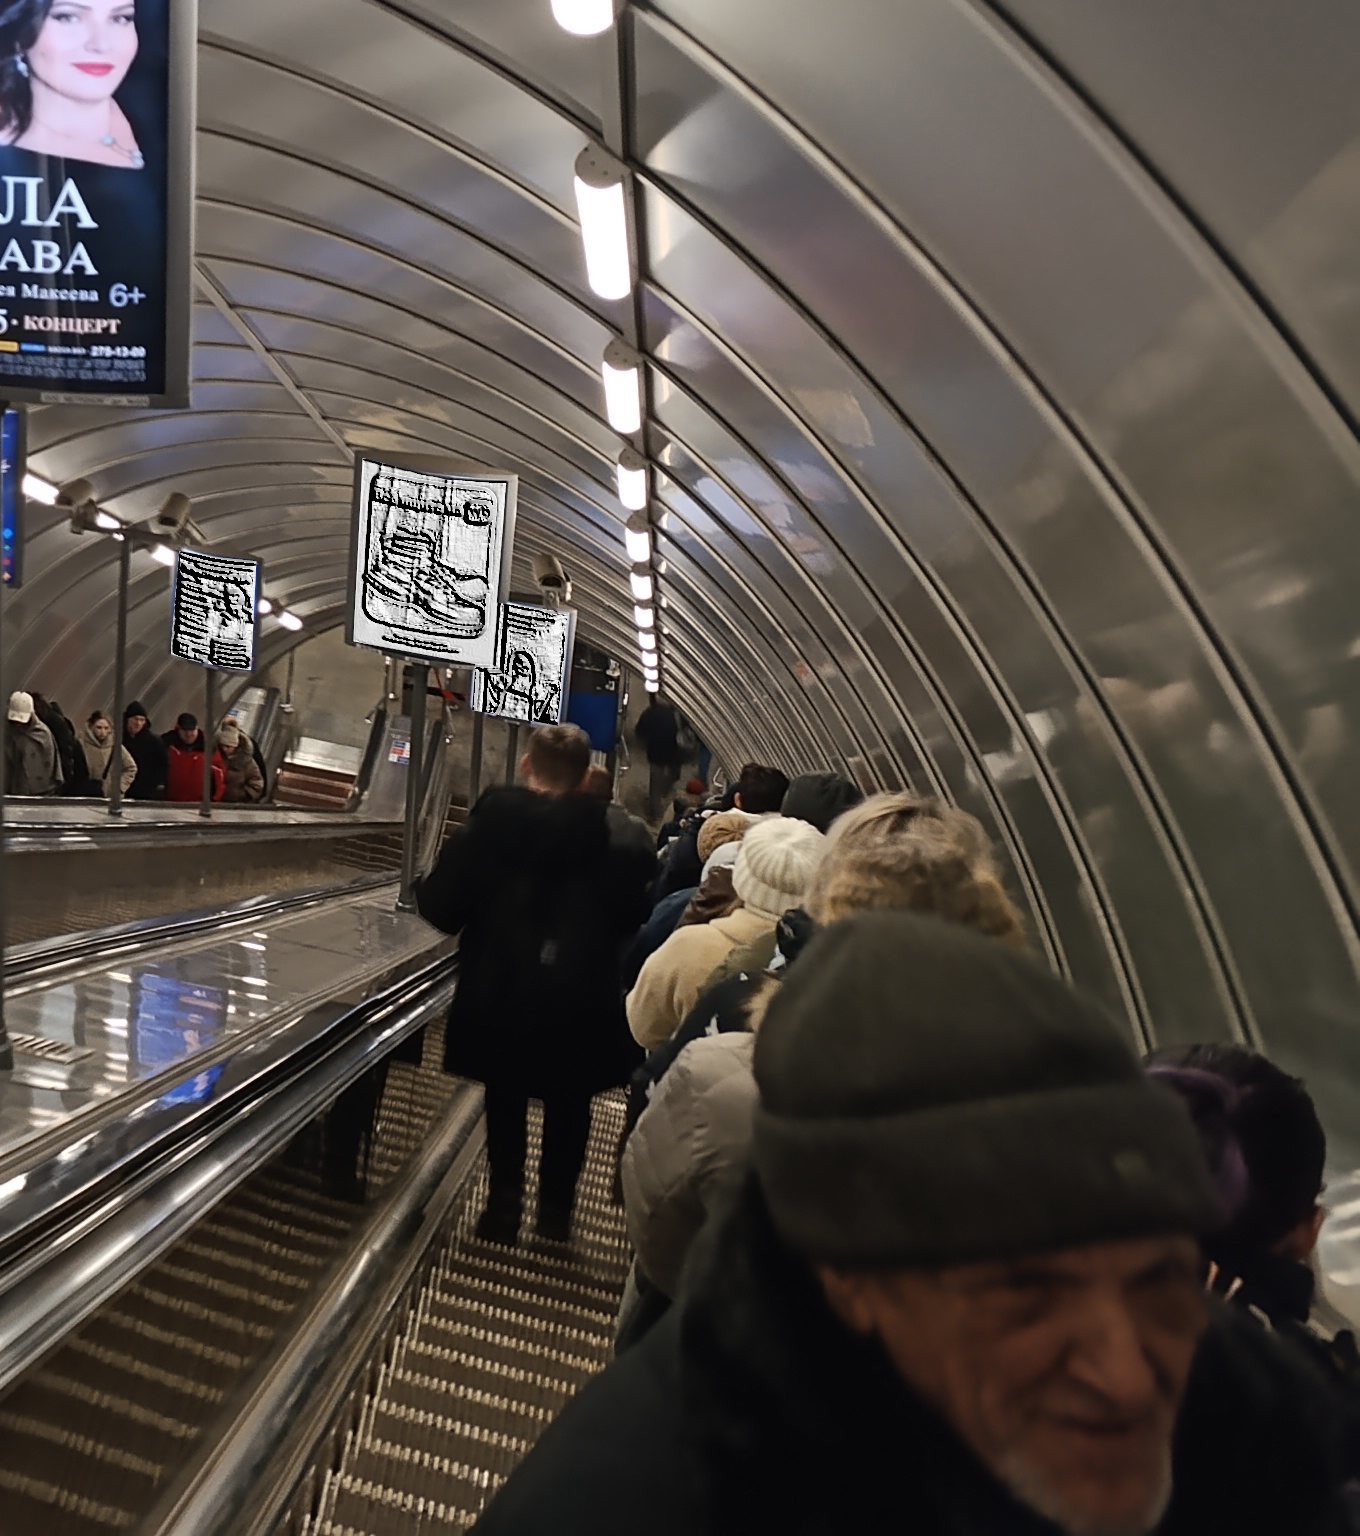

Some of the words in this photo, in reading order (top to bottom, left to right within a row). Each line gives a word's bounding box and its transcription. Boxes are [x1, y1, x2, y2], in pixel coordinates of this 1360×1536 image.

[21, 283, 99, 302] Макеева
[109, 282, 147, 308] 6+
[23, 315, 121, 335] КОНЦЕРТ
